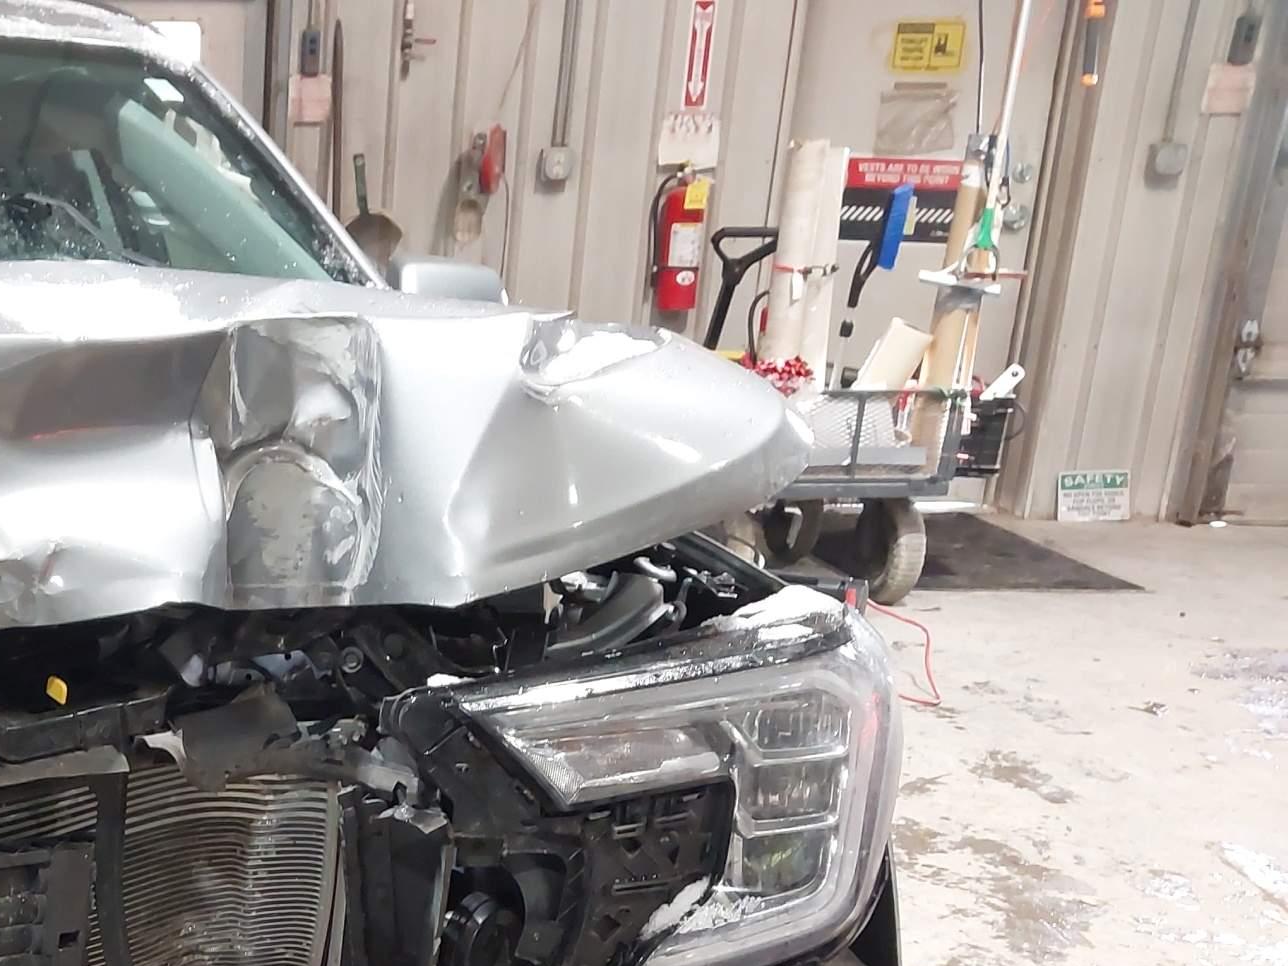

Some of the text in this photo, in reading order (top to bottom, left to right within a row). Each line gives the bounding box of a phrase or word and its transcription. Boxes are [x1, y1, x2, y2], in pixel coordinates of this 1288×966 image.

[858, 162, 886, 173] VESTS
[887, 162, 904, 173] ARE
[906, 163, 918, 173] TO
